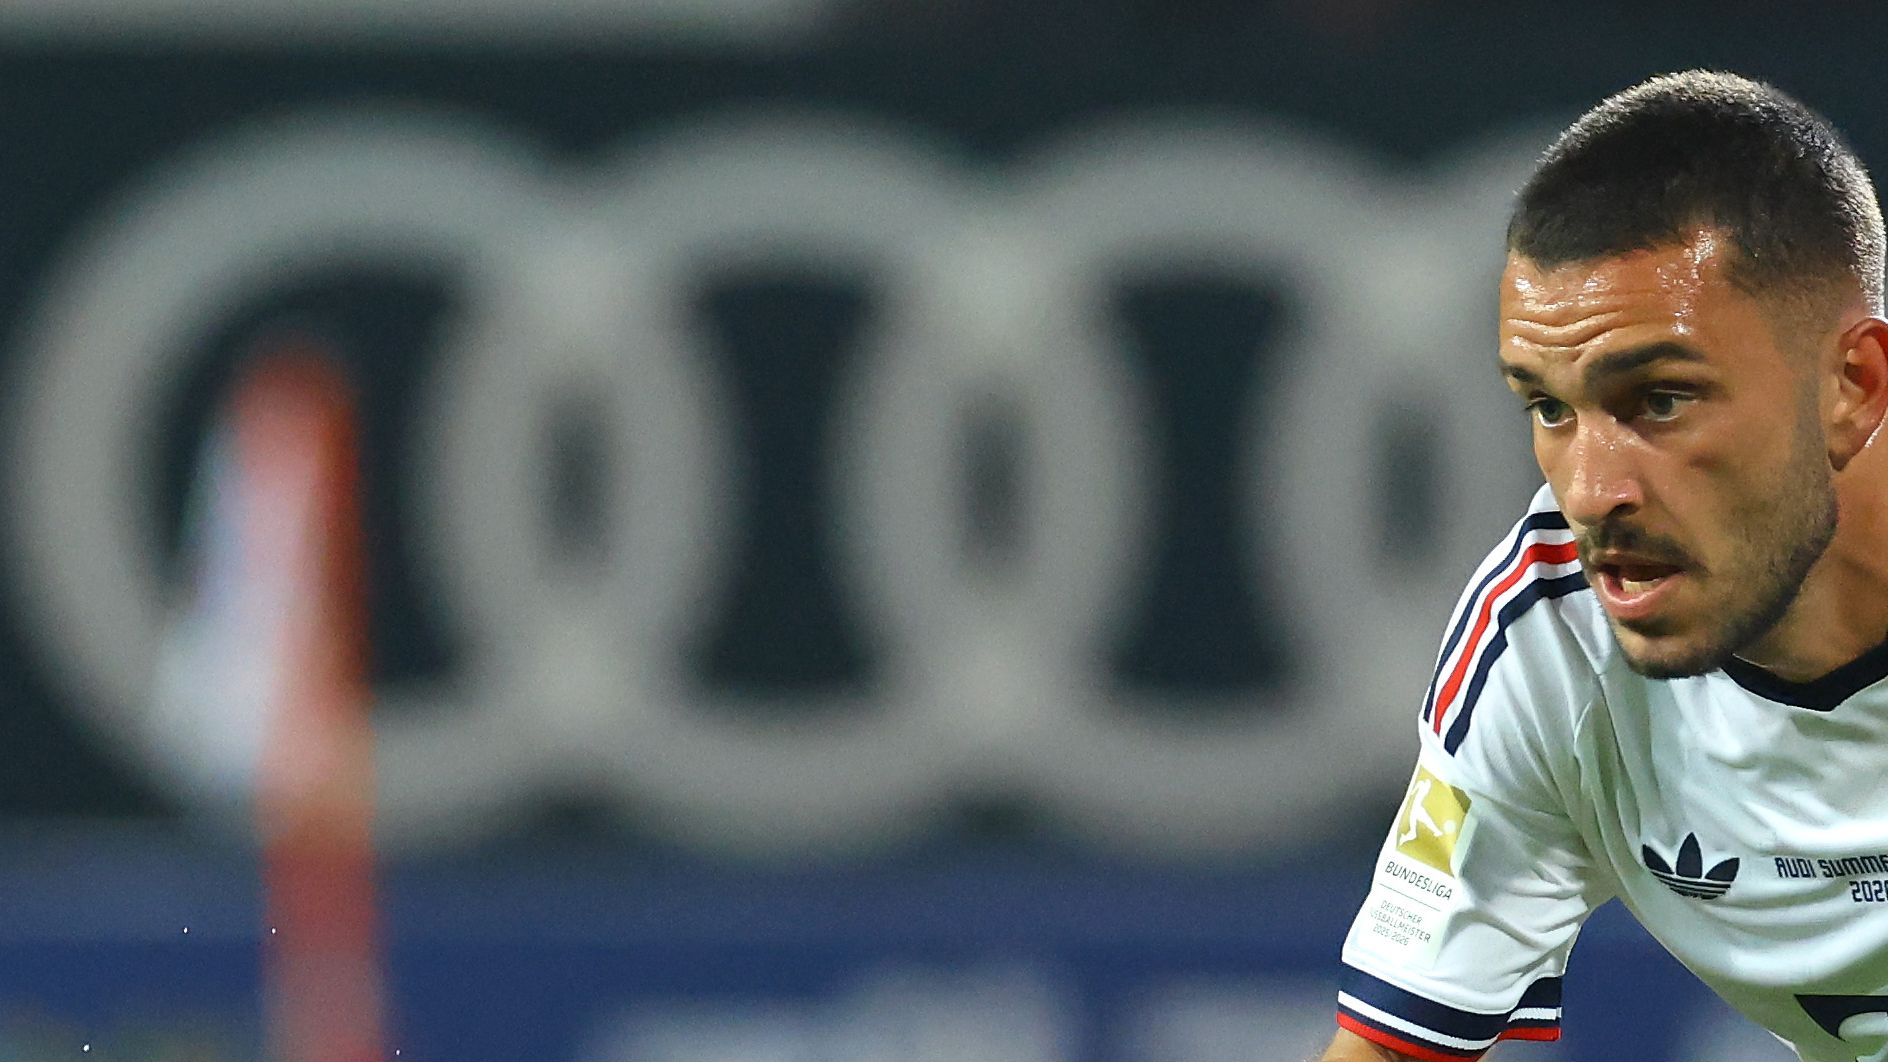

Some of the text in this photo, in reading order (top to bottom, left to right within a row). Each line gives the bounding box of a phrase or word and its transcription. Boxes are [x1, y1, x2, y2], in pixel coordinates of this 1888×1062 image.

[1774, 857, 1817, 878] AUDI
[1385, 861, 1452, 900] BUNDESLIGA
[1380, 900, 1422, 924] DEUTSCHER
